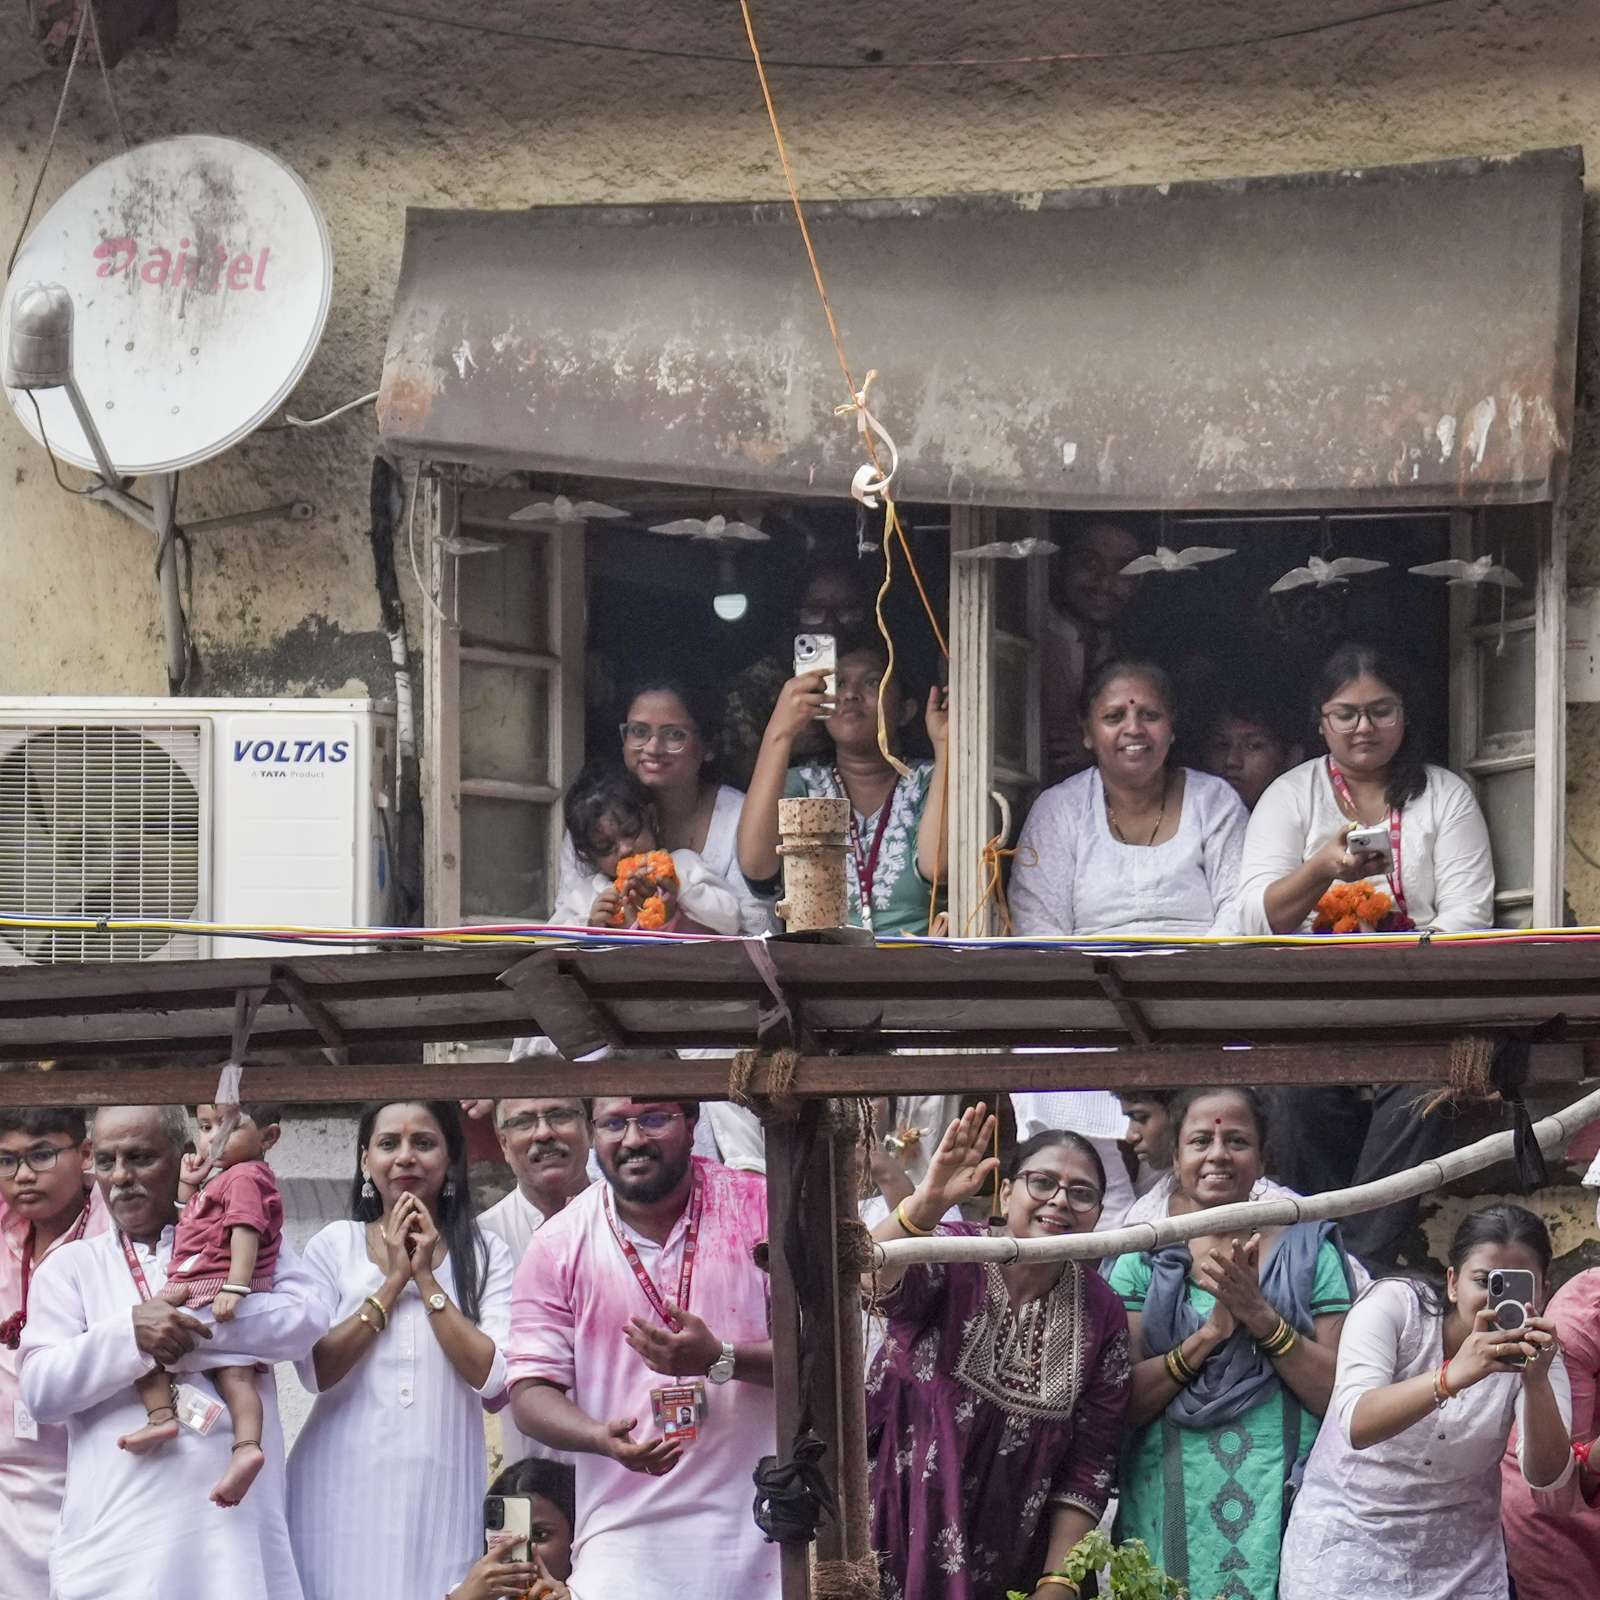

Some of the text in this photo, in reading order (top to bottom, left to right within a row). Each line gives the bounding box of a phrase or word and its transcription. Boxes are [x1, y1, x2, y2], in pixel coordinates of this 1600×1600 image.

[233, 740, 349, 763] VOLTAS
[260, 770, 287, 778] TATA
[290, 770, 325, 779] Product
